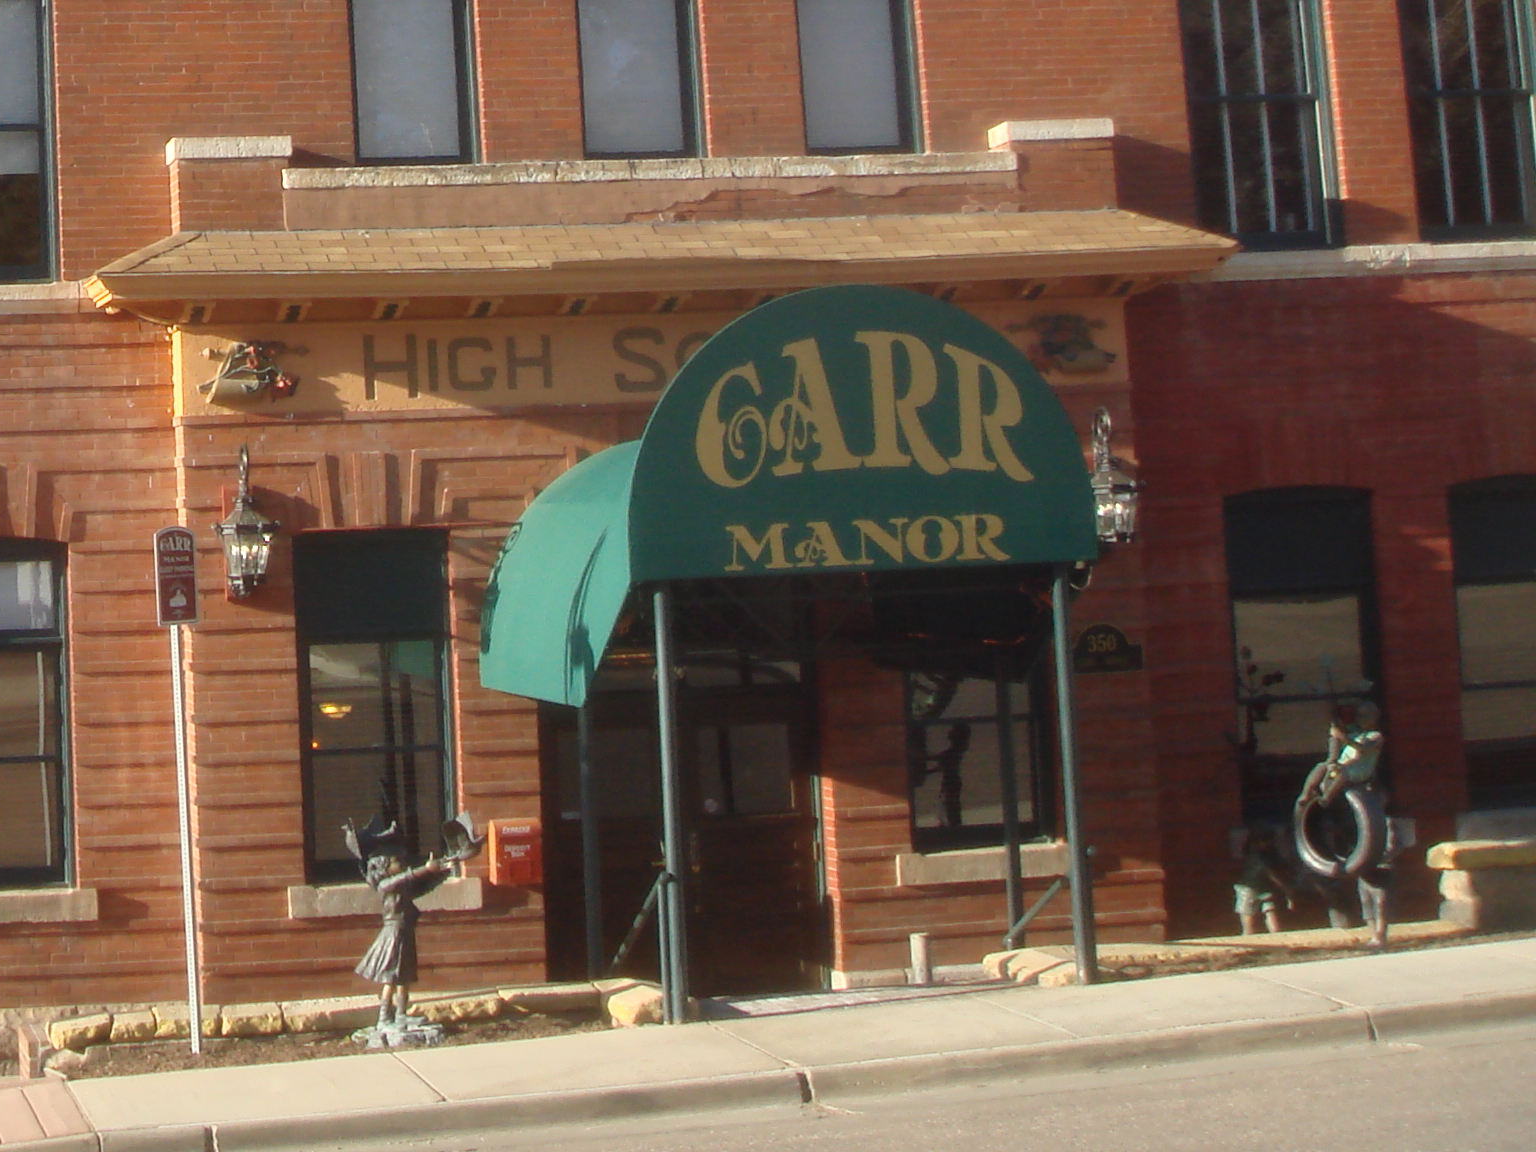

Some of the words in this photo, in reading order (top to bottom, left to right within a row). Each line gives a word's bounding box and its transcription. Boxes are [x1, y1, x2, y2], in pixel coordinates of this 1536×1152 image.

[364, 333, 554, 400] HIGH
[695, 330, 1035, 488] CARR
[160, 536, 192, 552] CARR
[724, 513, 1011, 572] MANOR
[1086, 633, 1117, 653] 350
